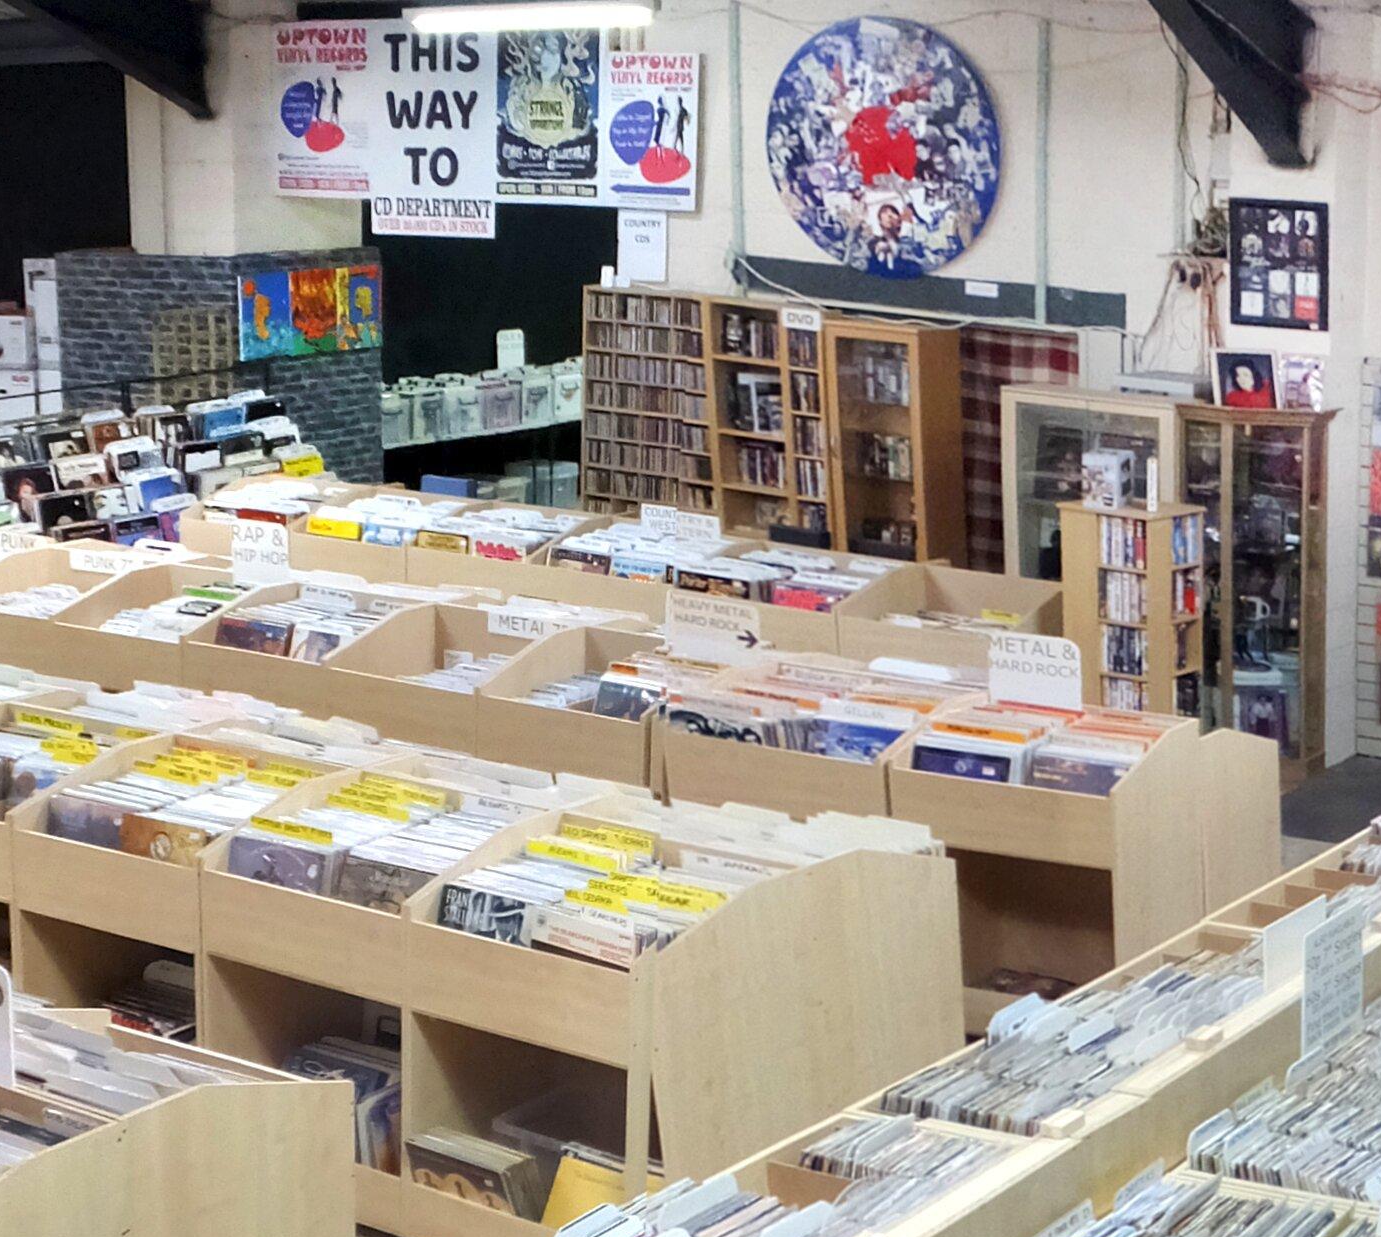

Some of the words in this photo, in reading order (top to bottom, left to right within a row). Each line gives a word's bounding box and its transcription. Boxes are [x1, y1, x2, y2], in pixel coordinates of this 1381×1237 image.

[277, 28, 366, 45] UPTOWN
[383, 32, 480, 73] THIS
[612, 56, 692, 69] UPTOWN
[385, 90, 478, 130] WAY
[404, 146, 458, 187] TO
[374, 197, 392, 215] CD
[397, 197, 491, 218] DEPARTMENT
[624, 220, 661, 228] COUNTRY
[786, 312, 814, 326] DVD
[232, 527, 264, 543] RAP
[271, 530, 284, 547] &
[84, 554, 115, 568] PUNK
[261, 552, 288, 566] HOP
[713, 602, 753, 619] METAL
[674, 613, 708, 626] HARD
[712, 617, 740, 630] ROCK
[991, 637, 1056, 659] METAL
[1063, 644, 1077, 660] &
[991, 658, 1034, 674] HARD
[1037, 664, 1078, 679] ROCK
